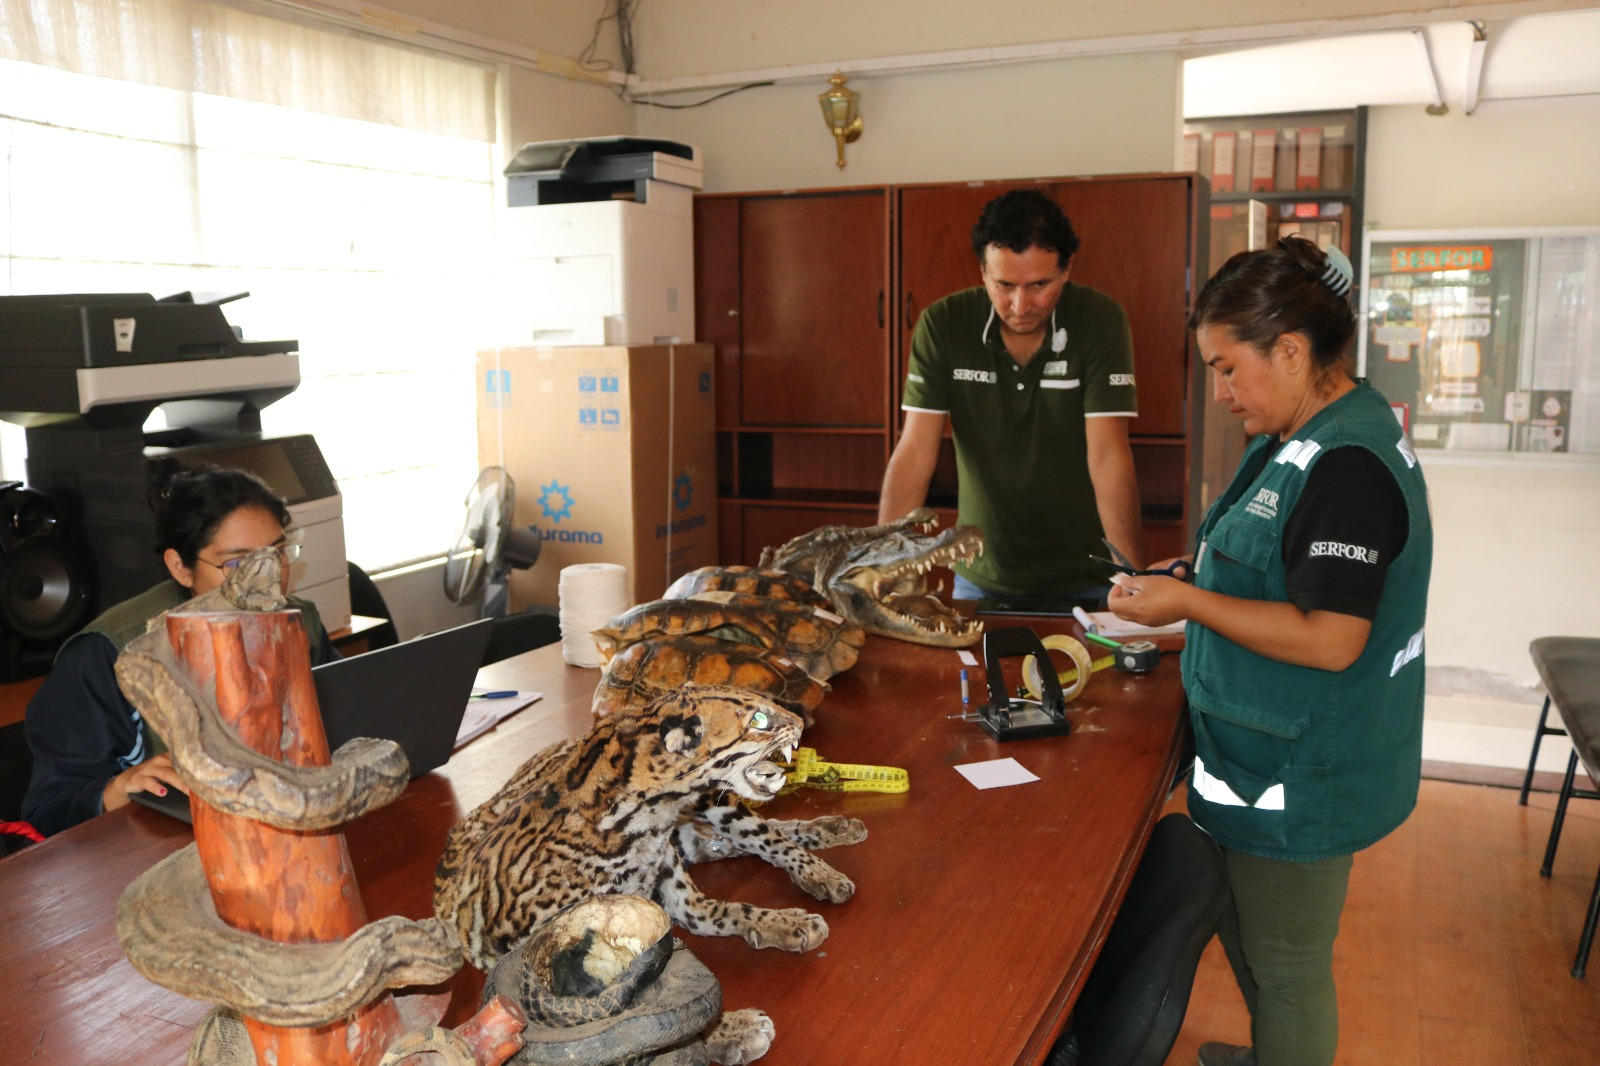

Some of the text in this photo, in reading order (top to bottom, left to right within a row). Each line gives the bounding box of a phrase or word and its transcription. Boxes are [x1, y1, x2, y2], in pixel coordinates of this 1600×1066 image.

[1395, 249, 1485, 268] SERFOR
[953, 368, 991, 384] SERFOR
[1310, 541, 1368, 563] SERFOR
